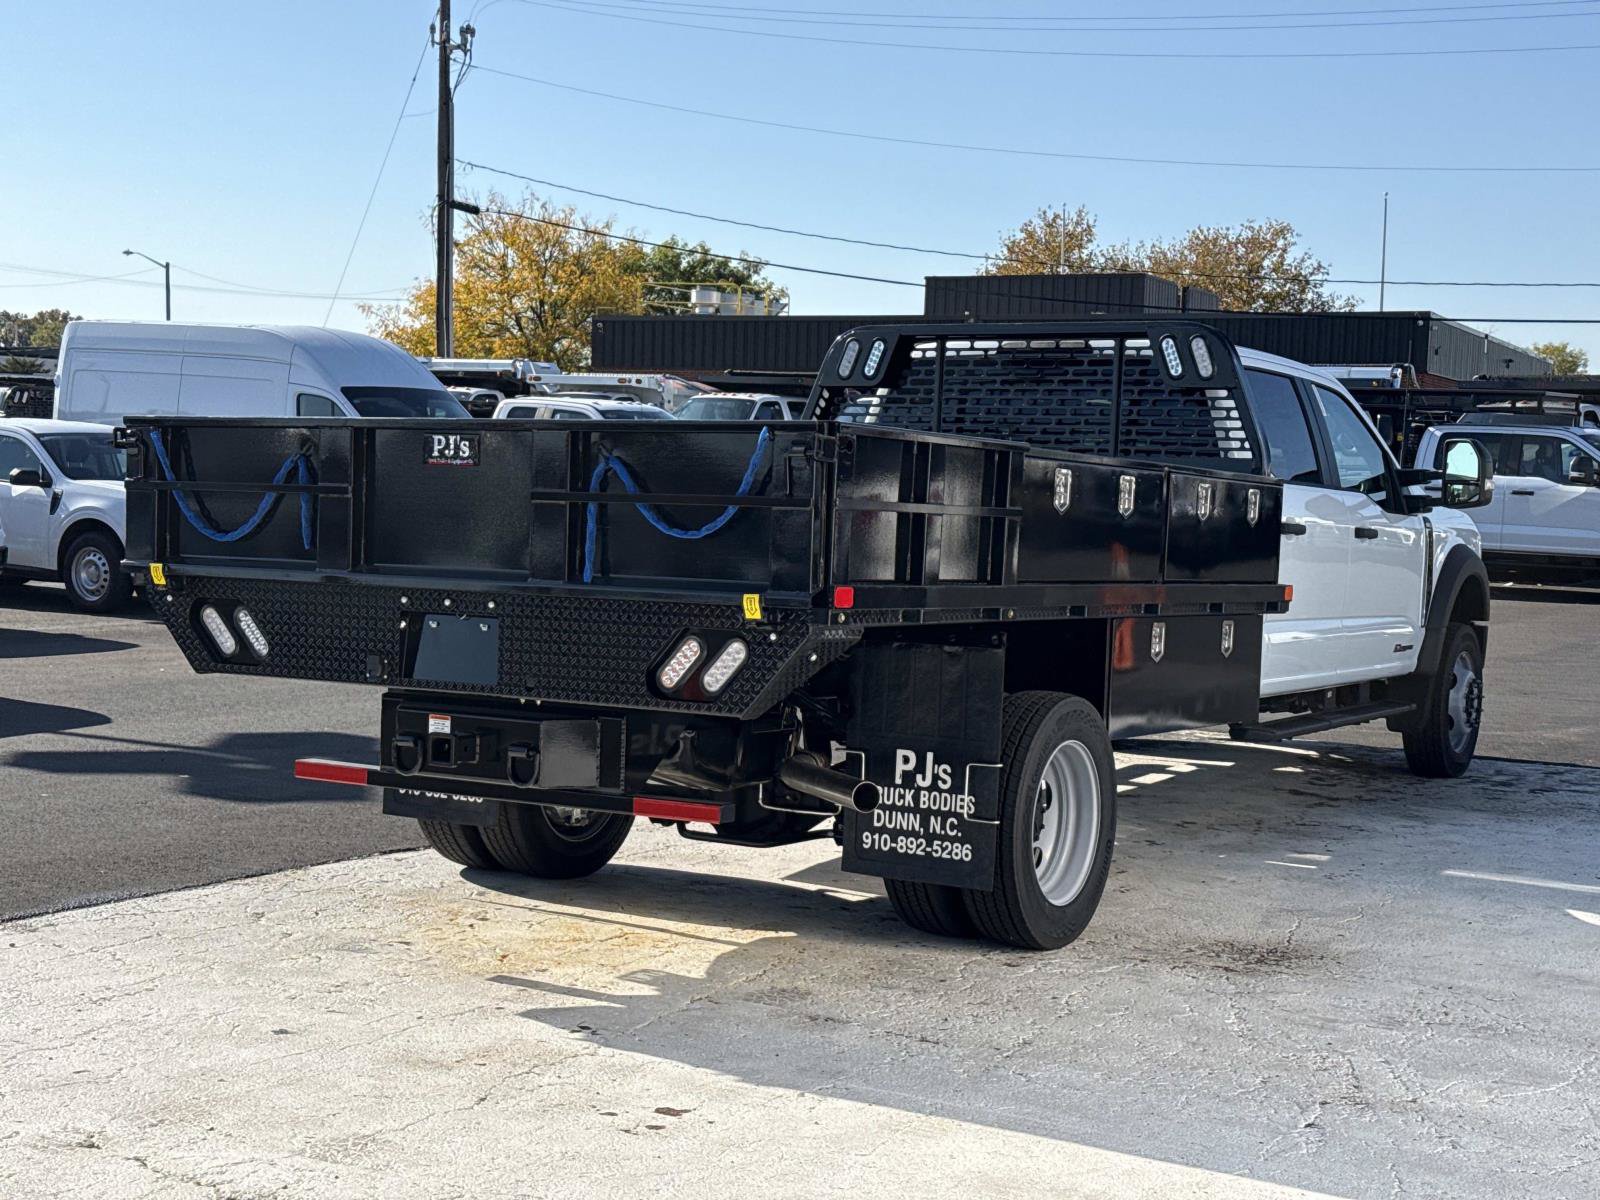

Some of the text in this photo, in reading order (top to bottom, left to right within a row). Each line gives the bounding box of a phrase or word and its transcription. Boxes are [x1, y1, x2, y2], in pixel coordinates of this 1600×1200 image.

[432, 434, 470, 457] PJ's
[895, 749, 951, 790] PJ's
[878, 785, 976, 814] UCK BODIES
[873, 809, 962, 837] DUNN, N.C.
[862, 831, 973, 861] 910-892-5286
